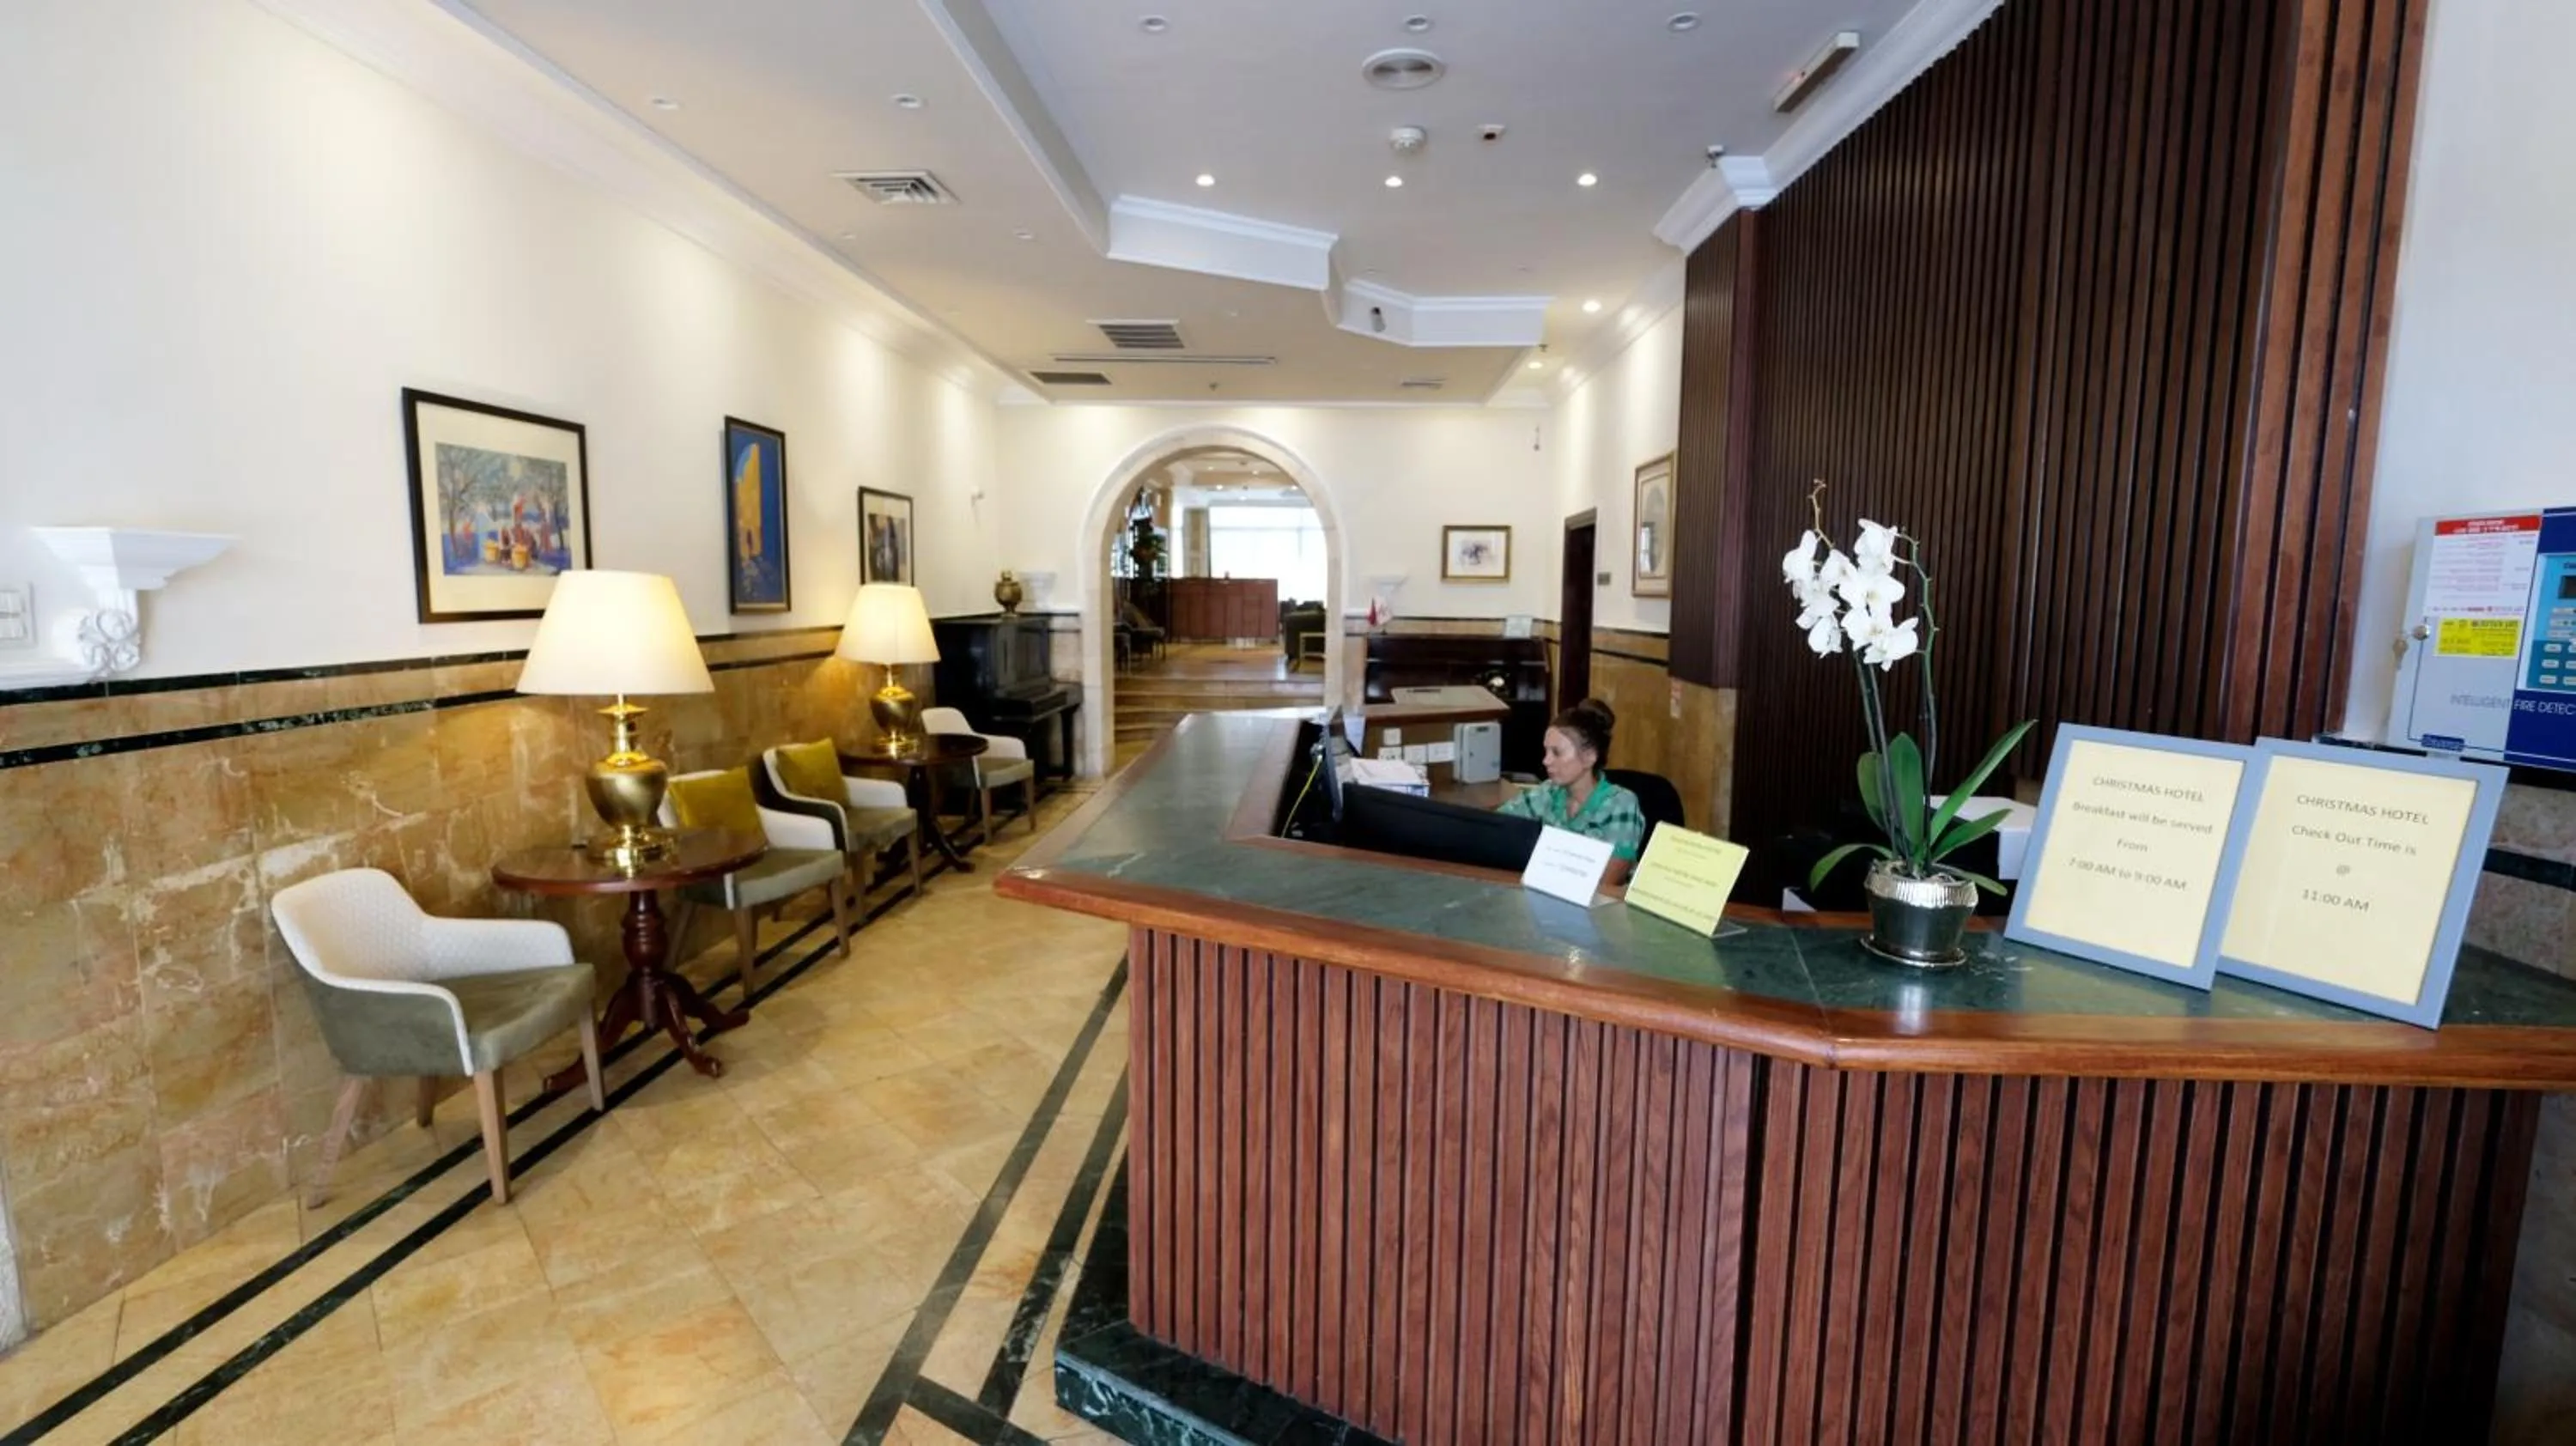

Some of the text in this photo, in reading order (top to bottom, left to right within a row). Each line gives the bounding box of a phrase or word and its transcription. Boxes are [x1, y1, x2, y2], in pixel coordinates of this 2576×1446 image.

[2514, 699, 2536, 712] FIRE
[2093, 776, 2204, 802] CHRISTMAS HOTEL
[2072, 801, 2213, 835] Breakfast will be served
[2297, 794, 2429, 825] CHRISTMAS HOTEL
[2117, 838, 2148, 852] From
[2292, 824, 2416, 856] Check Out Time is
[2094, 864, 2116, 876] AM
[2118, 869, 2131, 879] to
[2164, 878, 2187, 890] AM
[2302, 889, 2370, 912] 11:00 AM
